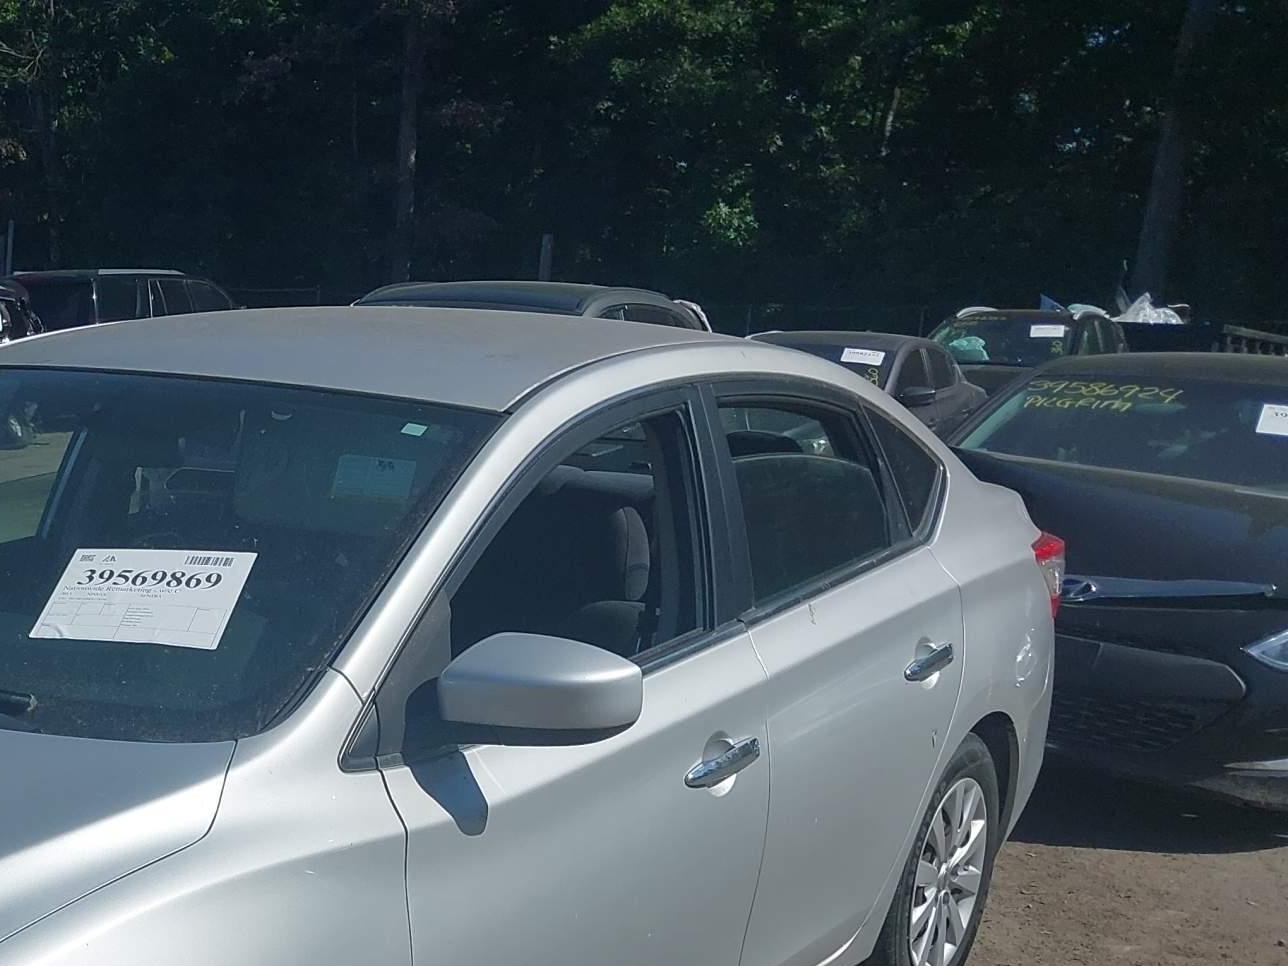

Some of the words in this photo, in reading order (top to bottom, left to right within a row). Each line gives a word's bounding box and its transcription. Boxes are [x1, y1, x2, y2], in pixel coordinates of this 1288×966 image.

[1027, 380, 1184, 404] 39586924
[1023, 395, 1133, 412] PILGRIM
[77, 569, 223, 589] 39569869
